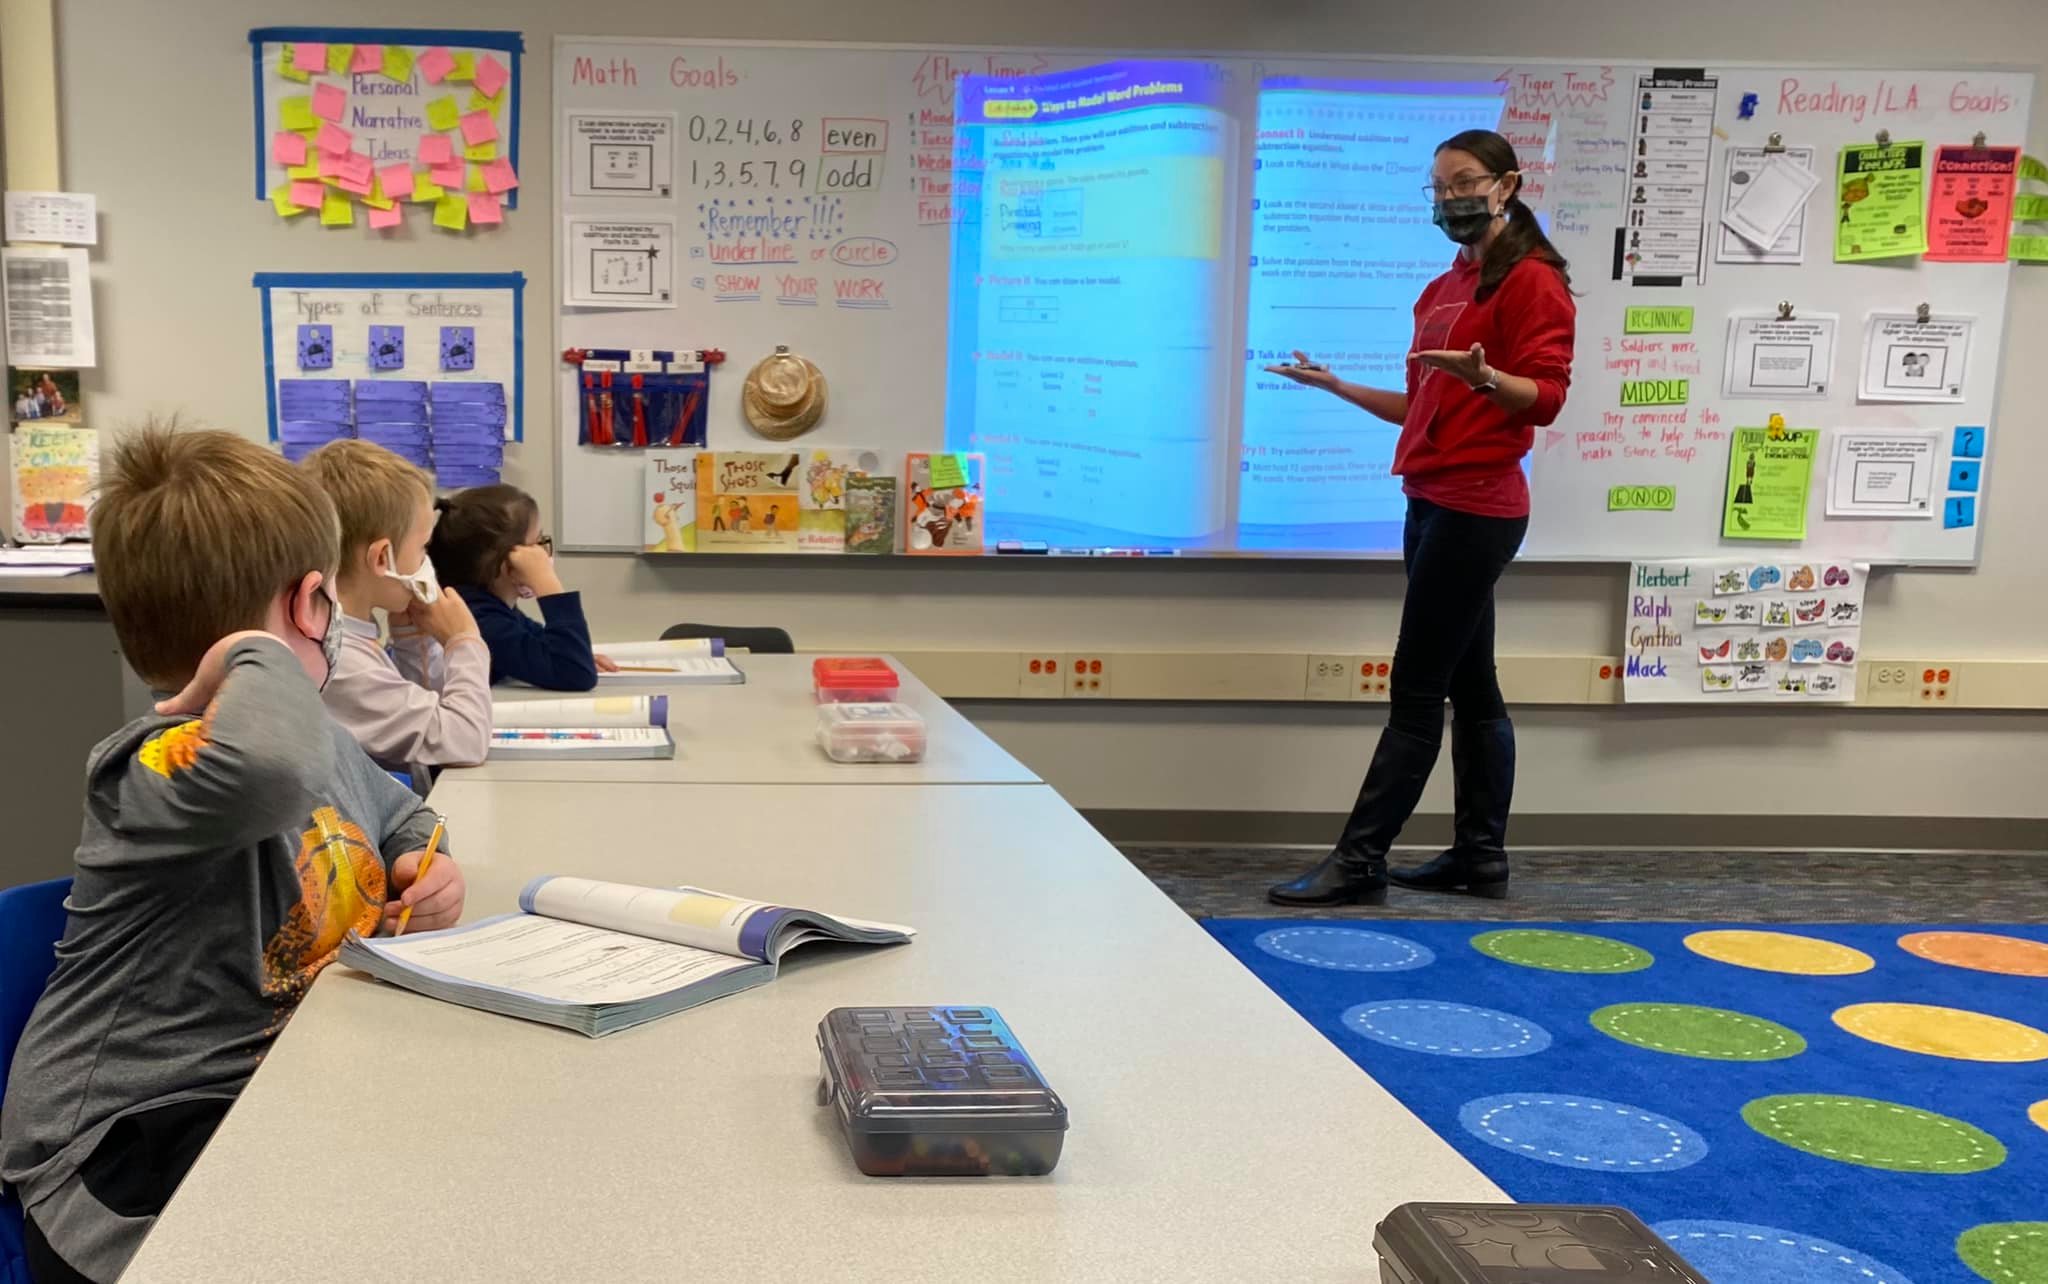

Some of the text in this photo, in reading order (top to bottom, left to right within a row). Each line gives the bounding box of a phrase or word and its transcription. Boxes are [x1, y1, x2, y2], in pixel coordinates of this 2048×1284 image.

[572, 56, 637, 86] Math
[351, 74, 420, 96] Personal
[1133, 81, 1184, 97] Problems
[1519, 72, 1597, 93] Tiger Time
[352, 106, 422, 129] Narrative
[1508, 107, 1552, 125] Monday
[366, 138, 410, 160] Ideas
[827, 128, 877, 148] even
[826, 158, 872, 188] odd
[810, 248, 827, 260] or
[835, 243, 889, 261] circle
[714, 273, 888, 298] SHOW YOUR WORK
[291, 291, 482, 322] Types of Sentences
[1603, 337, 1612, 351] 3
[1605, 358, 1641, 377] hungry
[1647, 356, 1667, 371] and
[1622, 380, 1688, 403] MIDDLE
[1603, 408, 1721, 426] They convinced the
[1639, 426, 1650, 441] to
[1660, 427, 1684, 448] help
[1581, 447, 1613, 461] make
[1664, 445, 1697, 463] Soup
[653, 459, 688, 473] Those
[720, 474, 759, 492] SHOES
[1611, 487, 1674, 507] END
[1636, 565, 1691, 588] Herbert
[1633, 595, 1672, 625] Ralph
[1630, 626, 1682, 655] Cynthia
[1626, 655, 1668, 678] Mack
